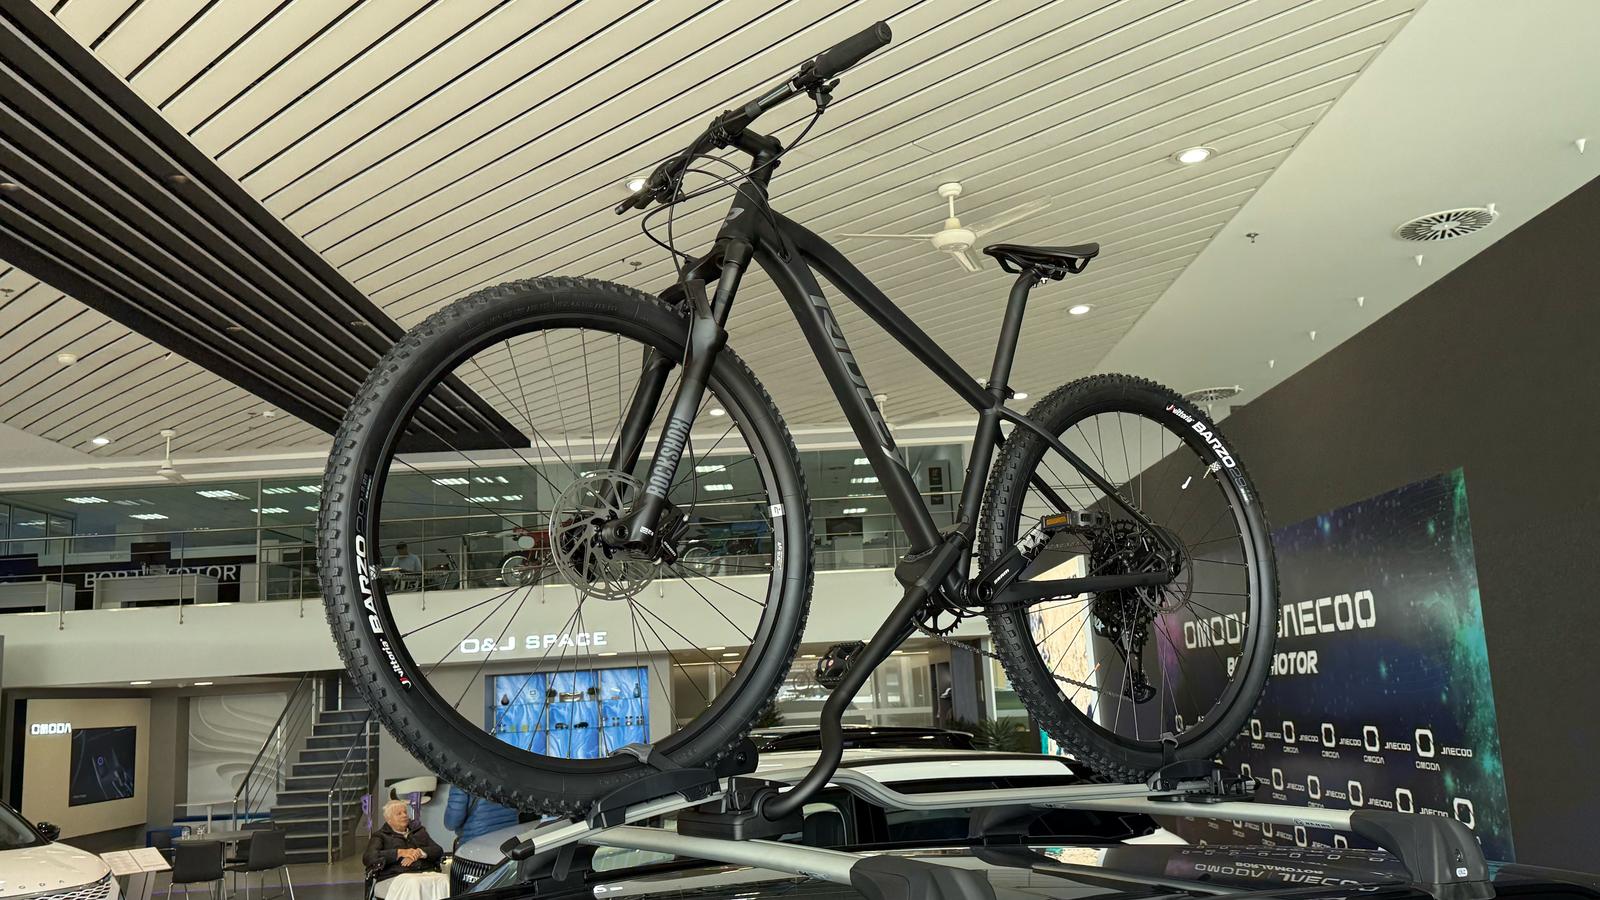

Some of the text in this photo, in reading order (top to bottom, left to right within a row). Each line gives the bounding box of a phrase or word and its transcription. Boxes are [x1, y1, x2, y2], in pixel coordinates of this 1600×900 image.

[646, 417, 690, 499] ROCKSHOX
[1192, 421, 1236, 468] BARZO
[355, 534, 384, 634] BARZO
[460, 631, 608, 654] O&J SPACE
